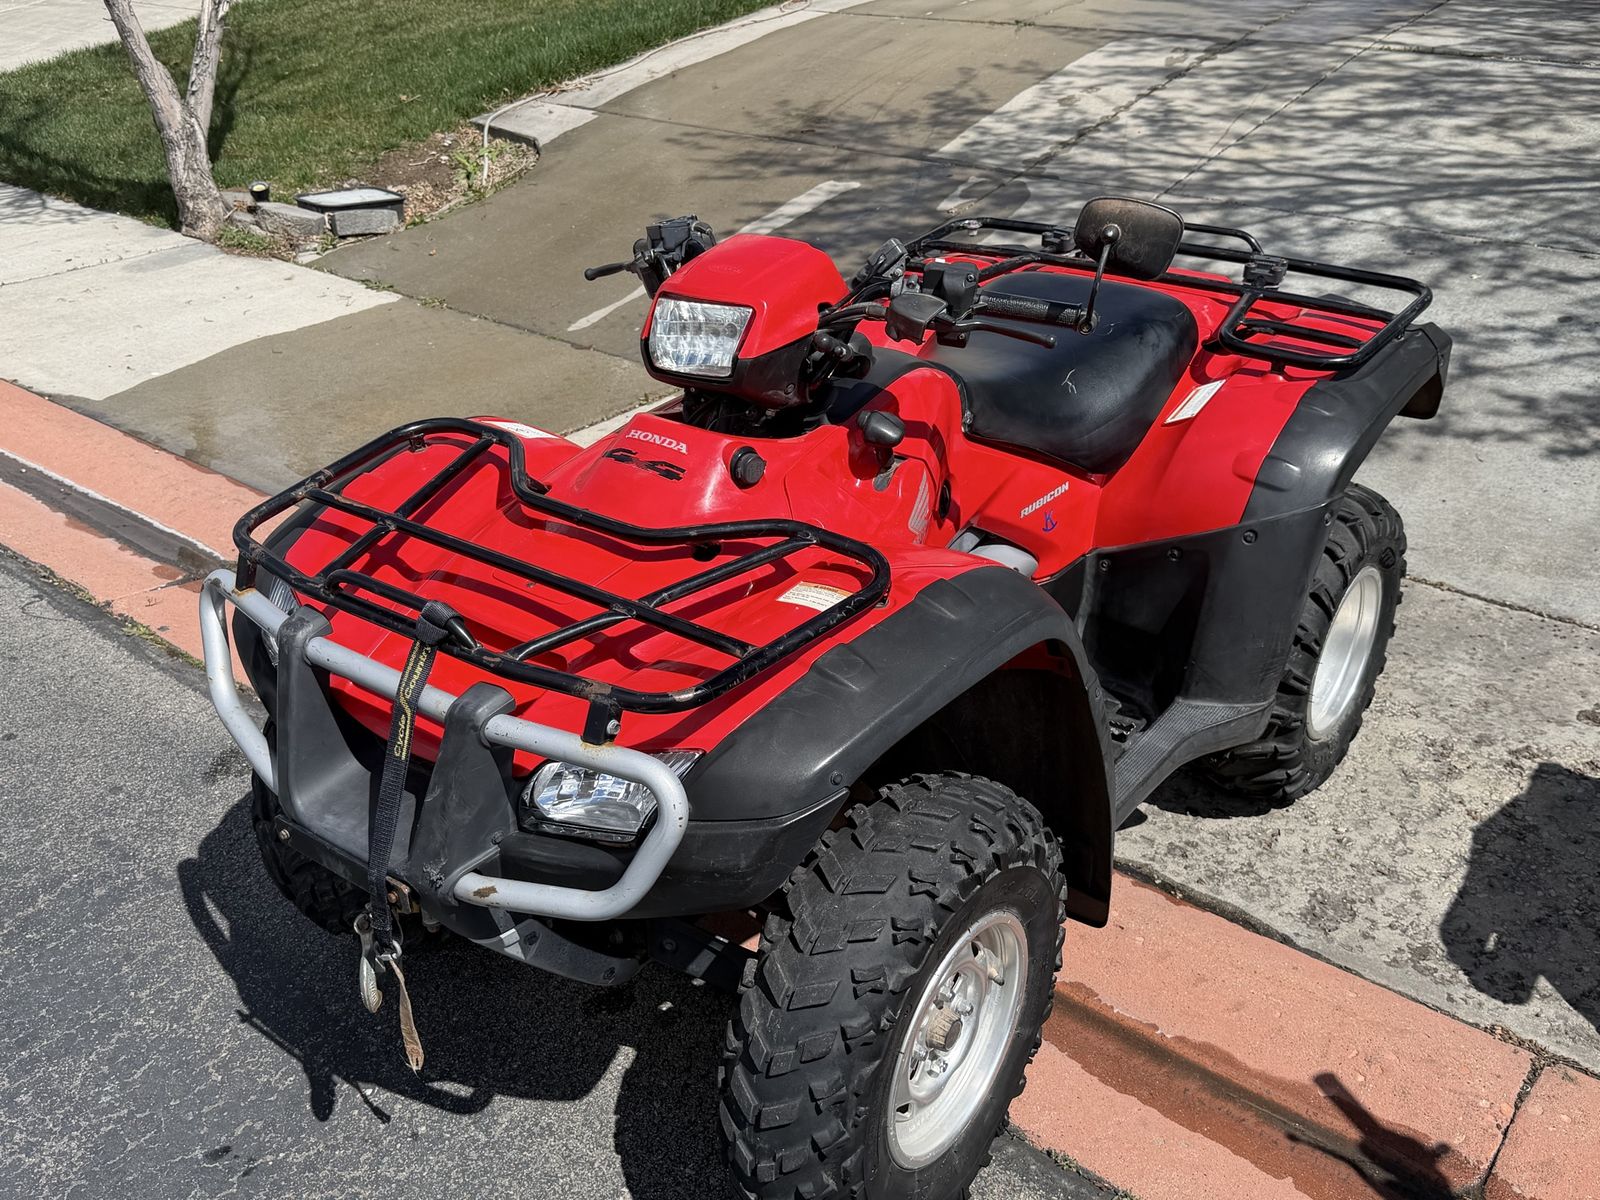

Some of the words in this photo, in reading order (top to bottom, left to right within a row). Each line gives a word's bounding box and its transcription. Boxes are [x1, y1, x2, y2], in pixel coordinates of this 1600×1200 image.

[626, 429, 688, 455] HONDA
[1020, 480, 1070, 519] RUBICON
[394, 714, 407, 757] Cycle
